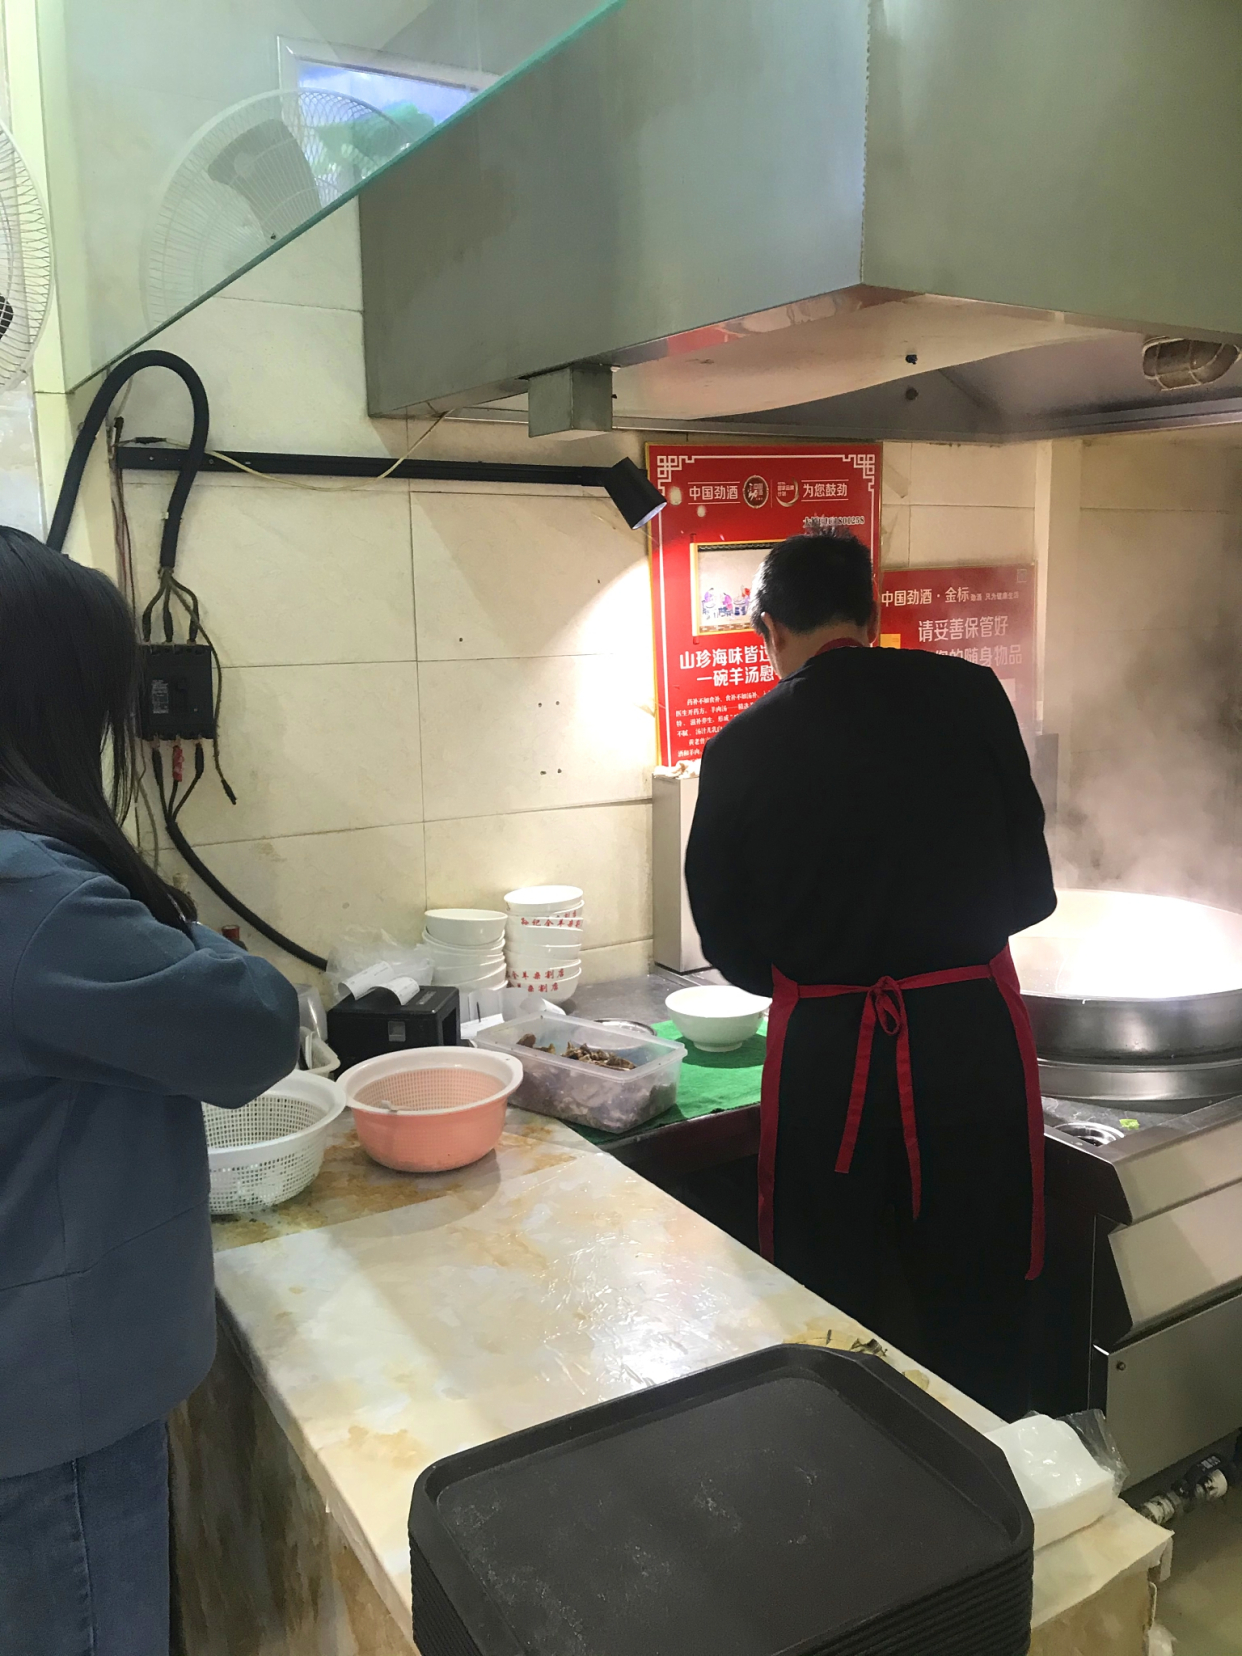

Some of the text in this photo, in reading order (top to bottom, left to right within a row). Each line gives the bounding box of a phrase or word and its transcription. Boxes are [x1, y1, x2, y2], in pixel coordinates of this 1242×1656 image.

[689, 485, 738, 501] 中国劲酒
[802, 483, 848, 498] 为您鼓劲
[918, 616, 1008, 643] 请妥善保管好
